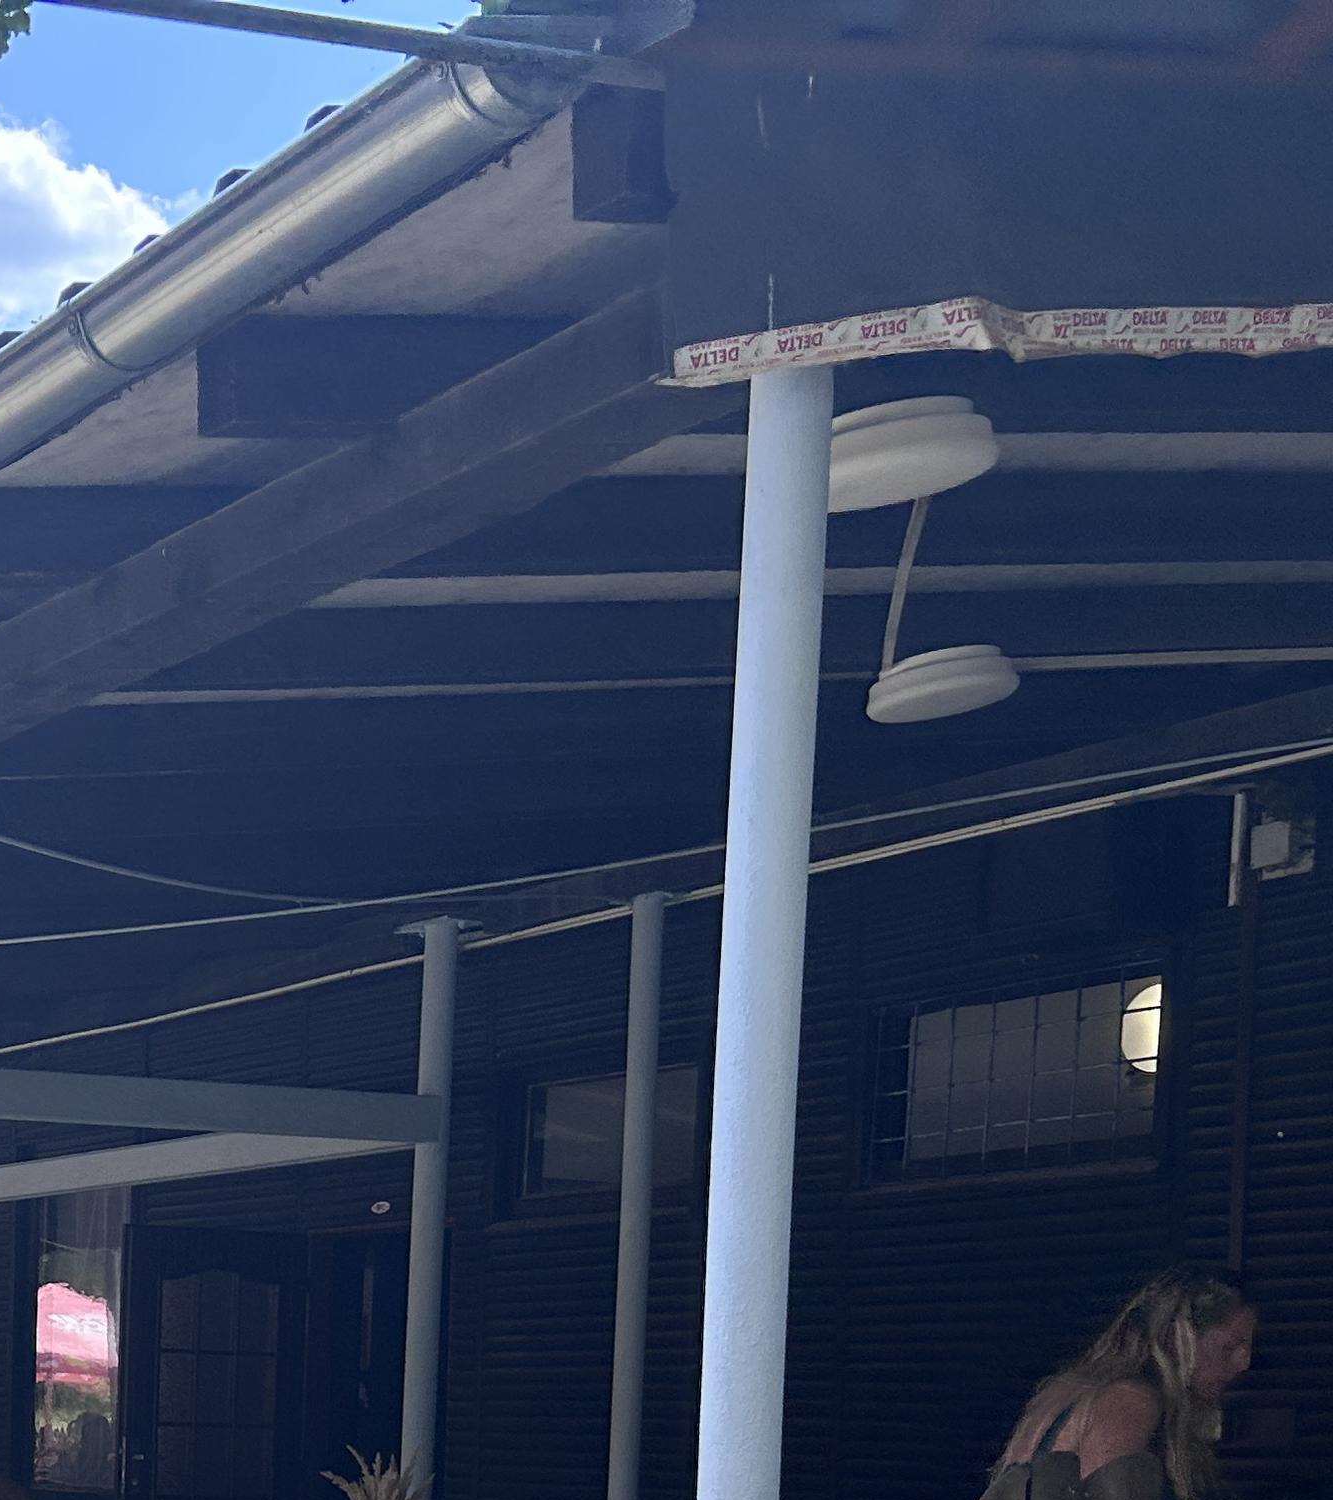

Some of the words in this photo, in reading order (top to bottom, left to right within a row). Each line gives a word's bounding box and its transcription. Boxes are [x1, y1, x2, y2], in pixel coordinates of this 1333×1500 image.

[943, 306, 984, 325] ELTA
[1073, 311, 1107, 327] DELTA
[1133, 311, 1168, 326] DELTA
[1192, 310, 1227, 325] DELTA
[1253, 310, 1290, 325] DELTA
[860, 319, 908, 339] DELTA
[777, 331, 824, 353] DELTA
[1160, 338, 1192, 352] DELTA
[1220, 337, 1255, 351] DELTA
[690, 346, 740, 369] DELTA
